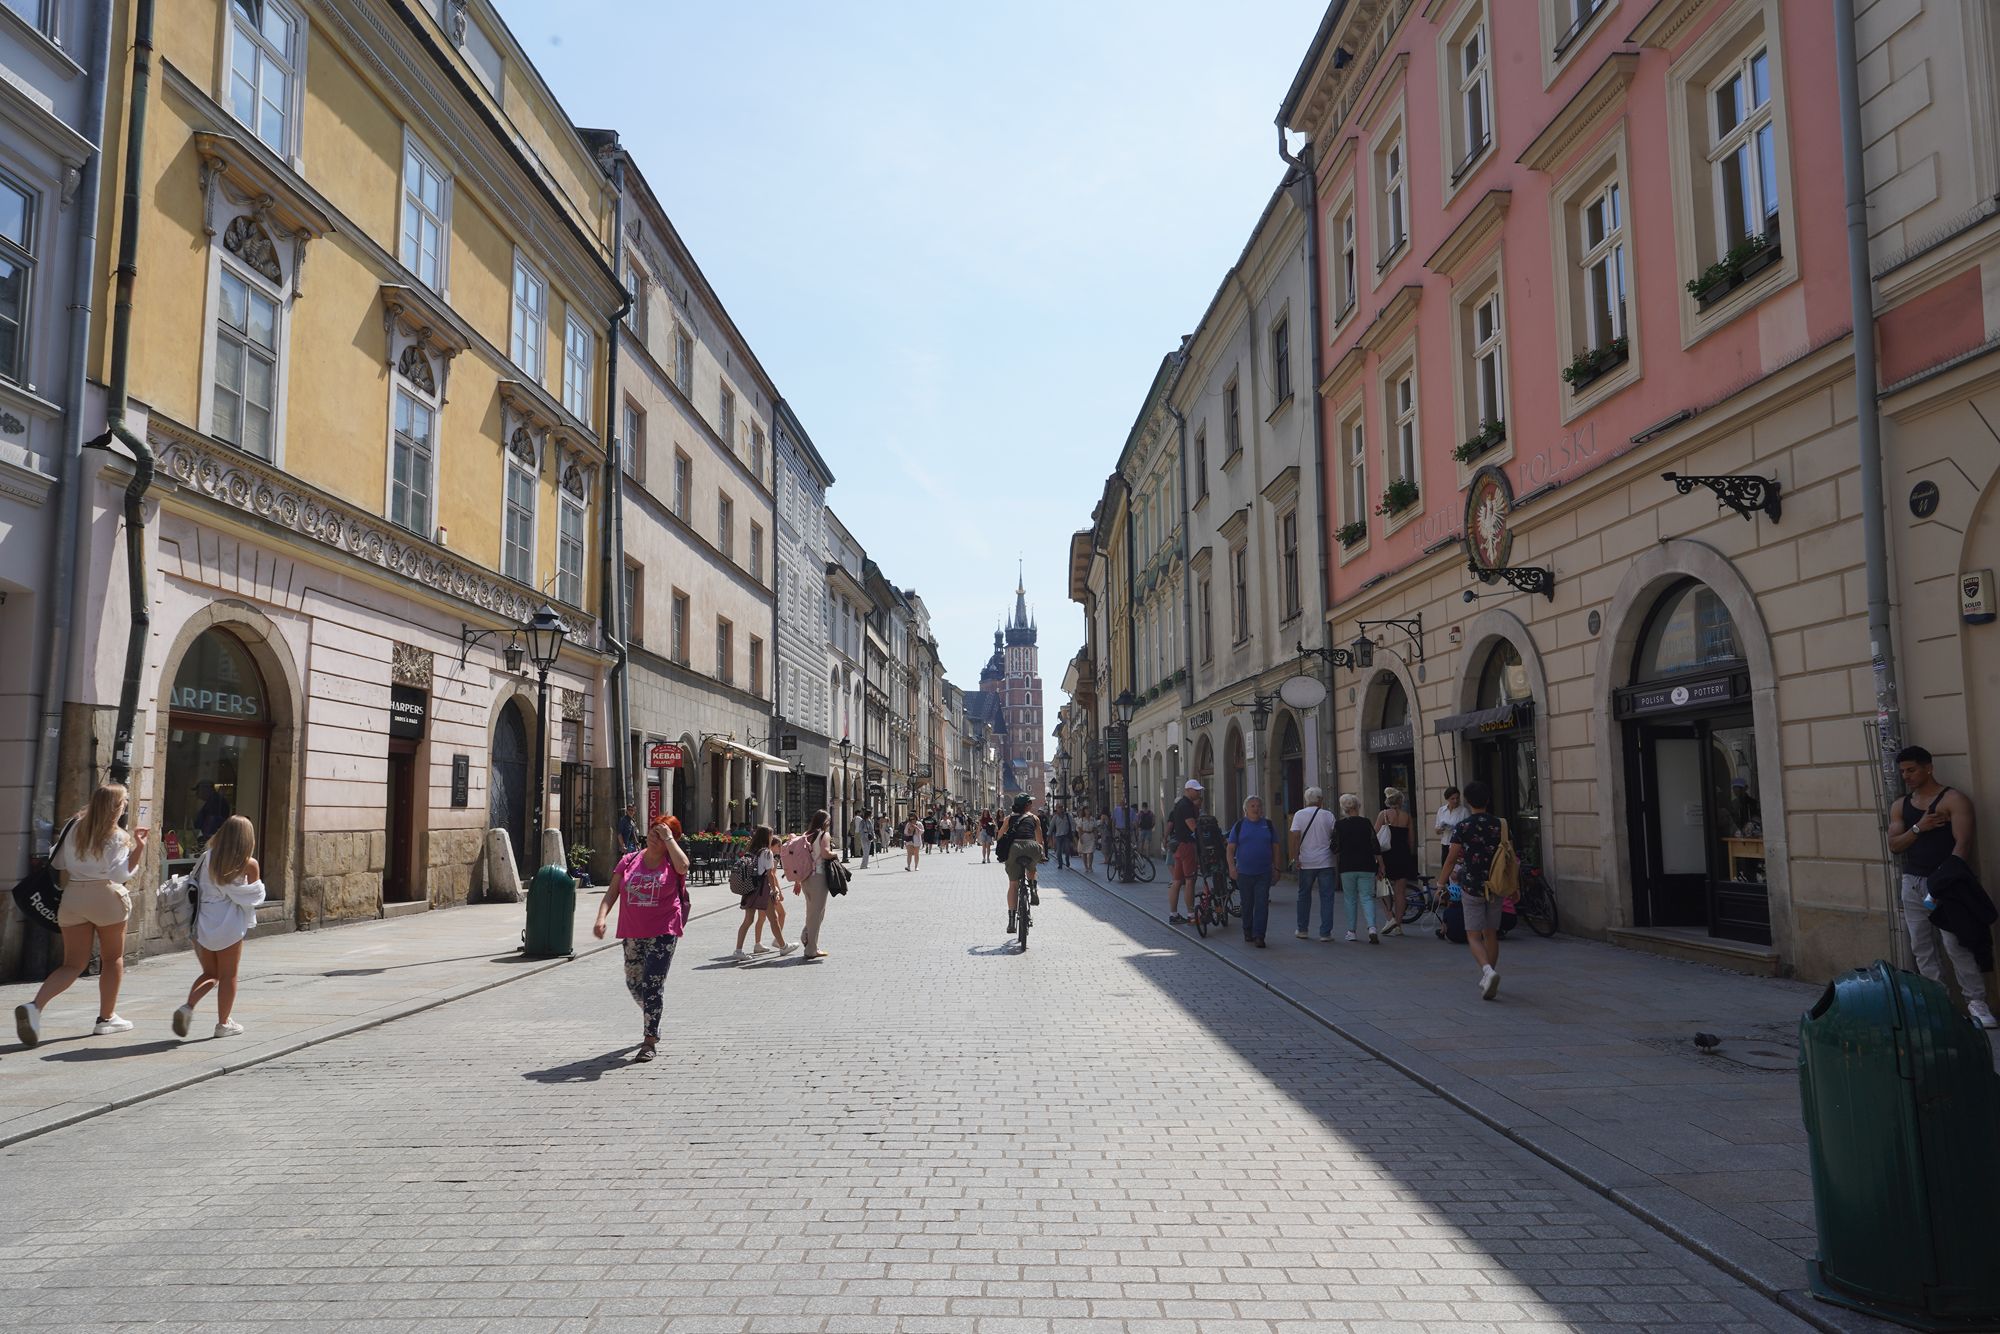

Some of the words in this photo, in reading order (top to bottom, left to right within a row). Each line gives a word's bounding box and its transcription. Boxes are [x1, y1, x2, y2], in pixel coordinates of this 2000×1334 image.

[1412, 501, 1463, 551] HOTEL
[1519, 421, 1600, 495] POLSKI
[169, 686, 257, 715] ARPERS
[390, 701, 423, 715] HARPERS
[1641, 695, 1665, 705] POLISH
[1693, 685, 1724, 697] POTTERY
[29, 891, 58, 924] Reebo
